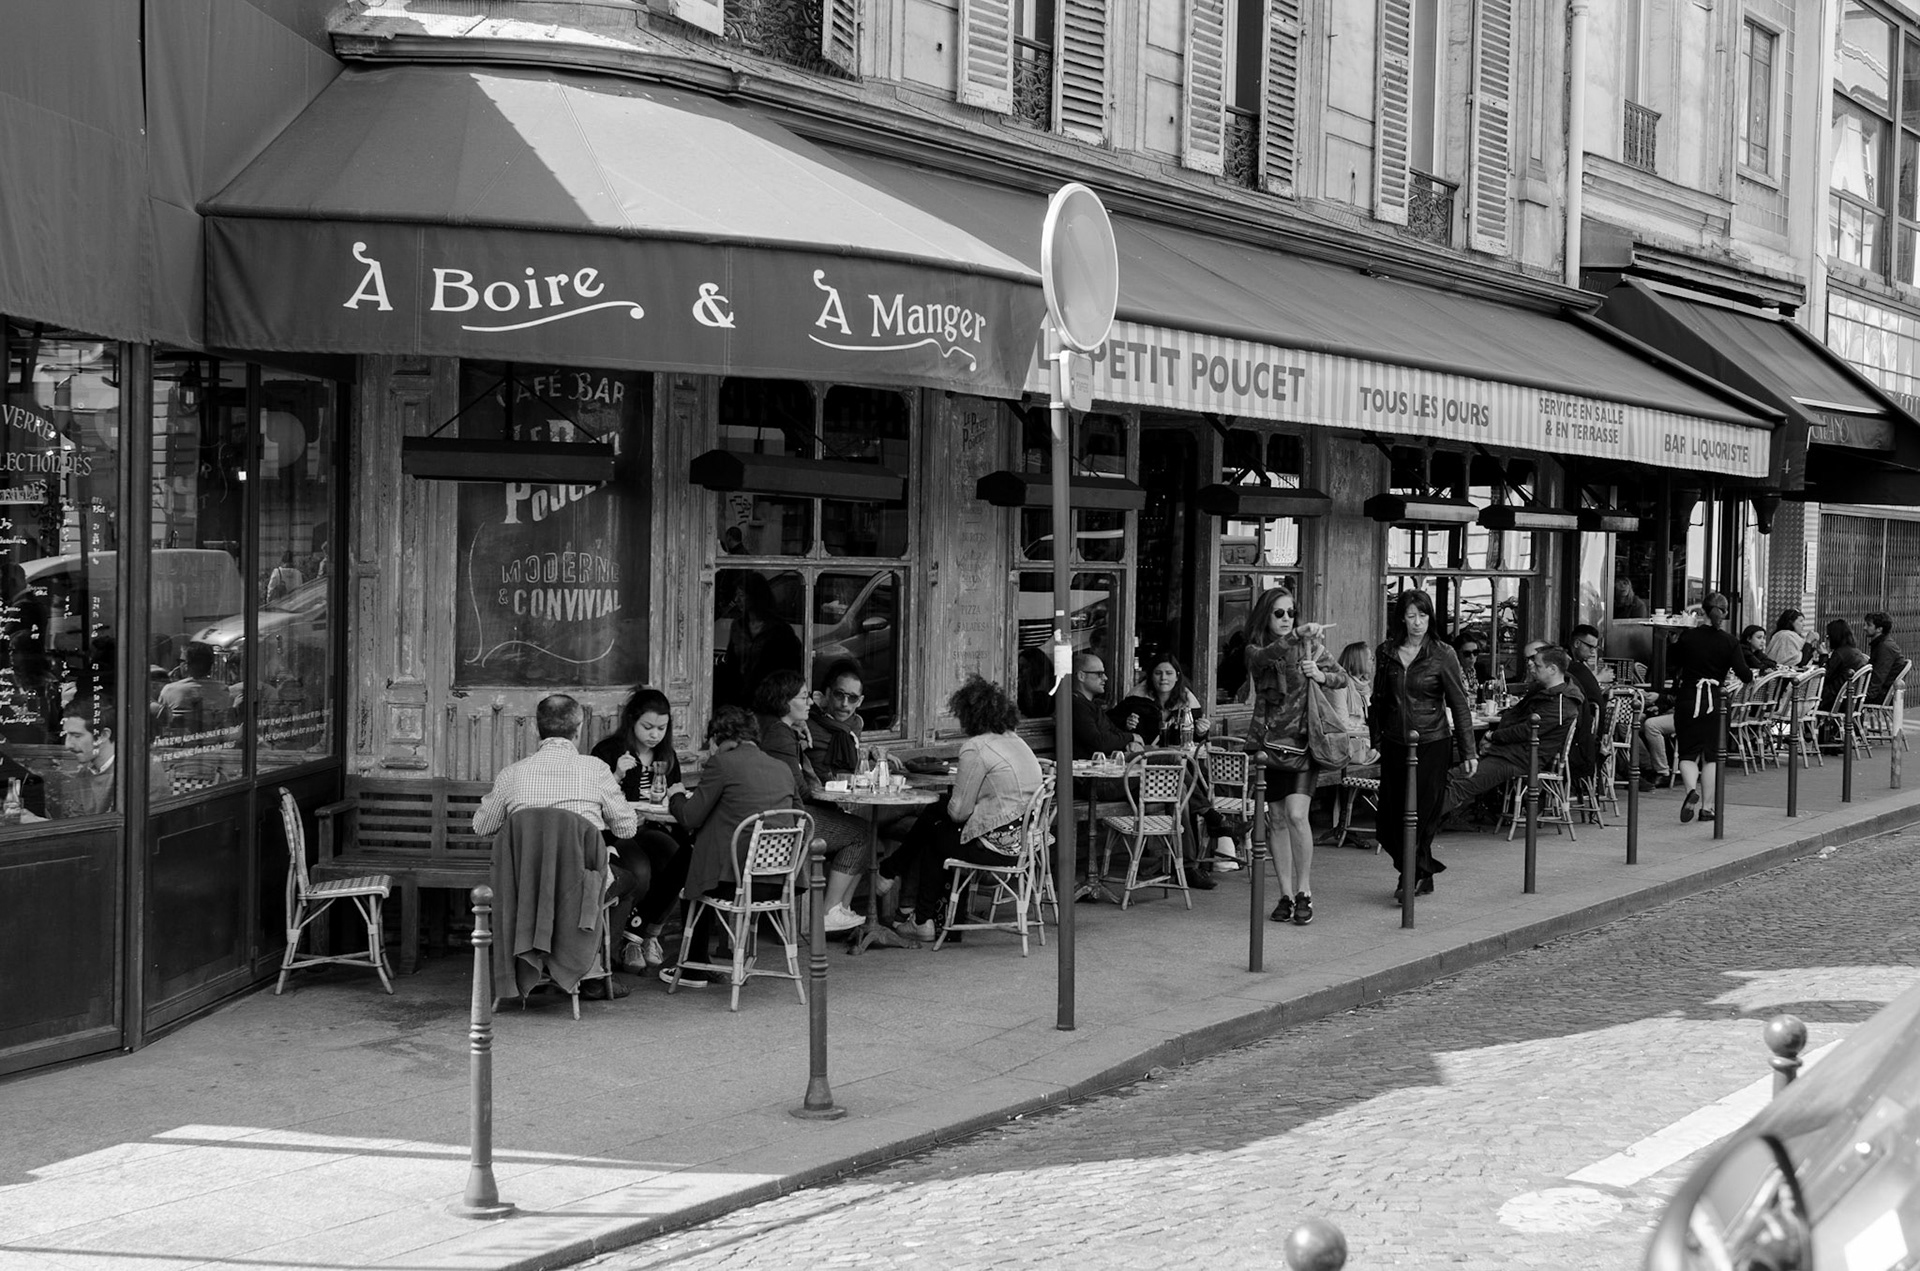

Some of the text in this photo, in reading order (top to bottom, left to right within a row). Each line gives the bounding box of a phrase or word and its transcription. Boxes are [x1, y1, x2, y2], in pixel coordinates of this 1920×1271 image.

[430, 267, 605, 313] Boire
[692, 282, 736, 328] &
[868, 293, 986, 342] Manger
[568, 372, 625, 404] BAR
[1191, 352, 1305, 403] POUCET
[1360, 386, 1489, 427] TOUS LES JOURS
[1539, 397, 1623, 425] SERVICE EN SALLE
[1545, 419, 1619, 444] & EN TERRASSE
[1664, 433, 1749, 463] BAR LIQUORISTE
[502, 551, 620, 584] MODERNE
[513, 588, 622, 622] CONVIVIAL
